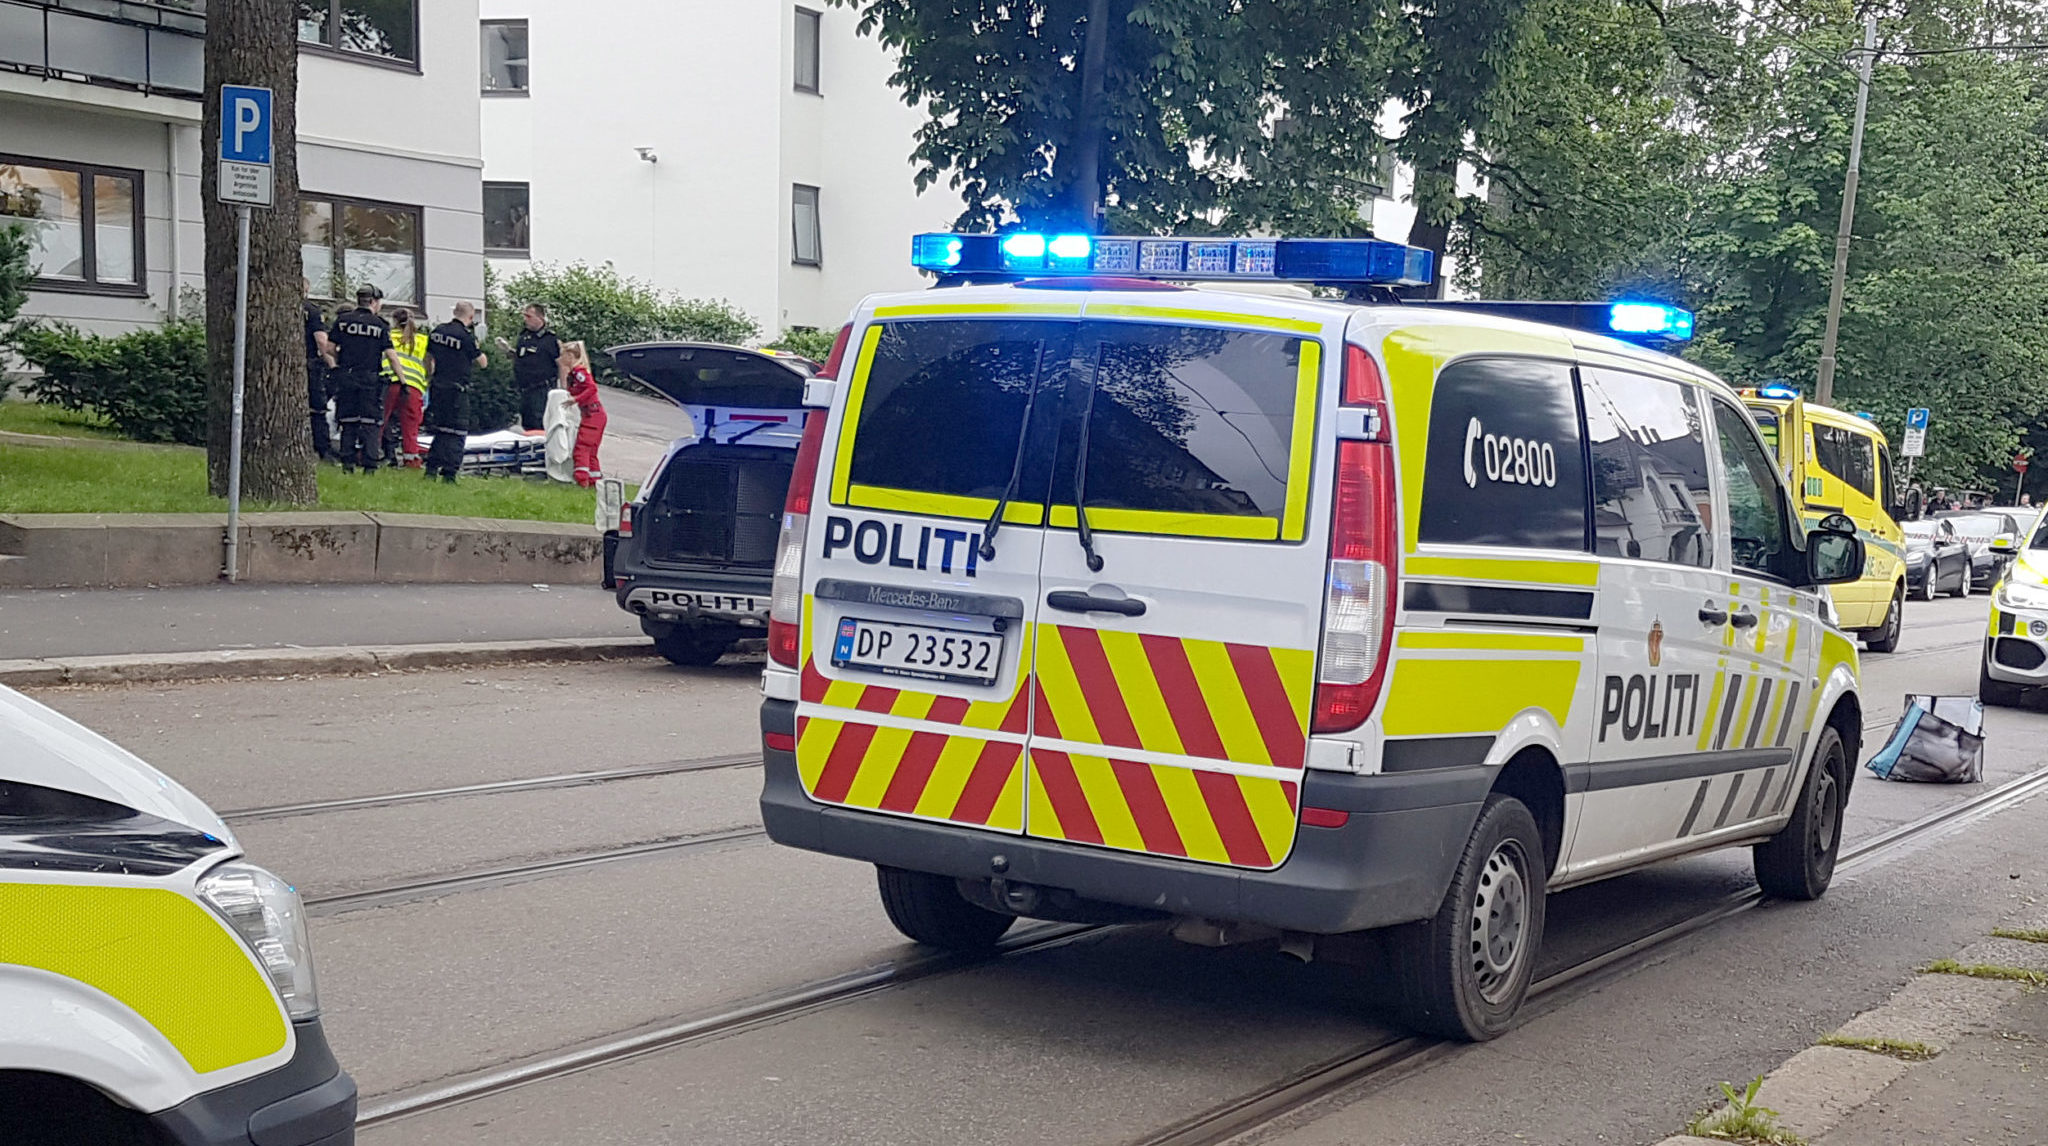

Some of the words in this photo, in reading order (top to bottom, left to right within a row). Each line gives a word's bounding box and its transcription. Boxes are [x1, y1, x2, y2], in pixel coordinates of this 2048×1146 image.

[234, 97, 260, 153] P
[1911, 411, 1924, 424] P
[1483, 433, 1557, 488] 02800
[822, 515, 981, 578] POLITI
[651, 591, 755, 612] POLITI
[866, 585, 960, 611] Mercedes-Benz
[840, 644, 849, 655] N
[856, 627, 893, 660] DP
[903, 633, 991, 673] 23532
[1598, 673, 1700, 743] POLITI
